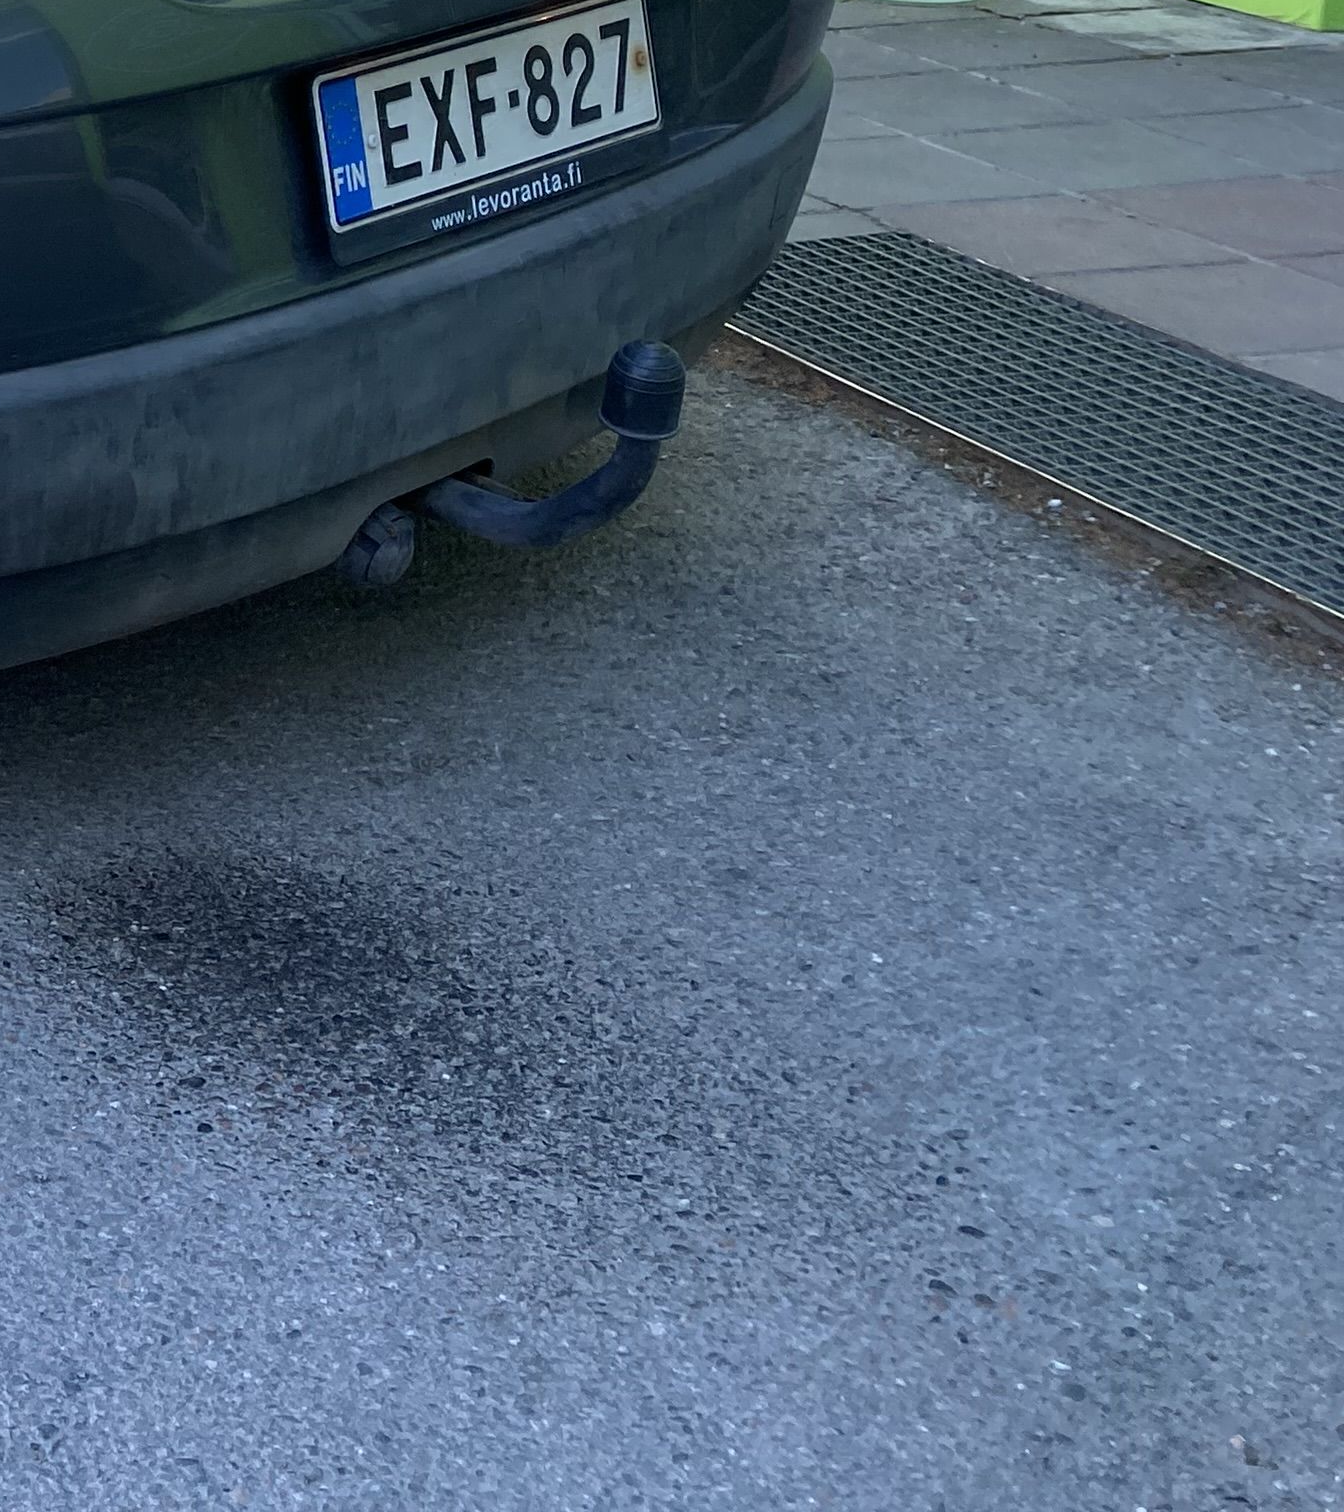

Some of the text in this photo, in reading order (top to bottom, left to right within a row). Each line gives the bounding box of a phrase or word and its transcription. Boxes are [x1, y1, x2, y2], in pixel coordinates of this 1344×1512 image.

[332, 17, 631, 198] FIN EXF-827
[430, 160, 583, 232] www.levoranta.fi
